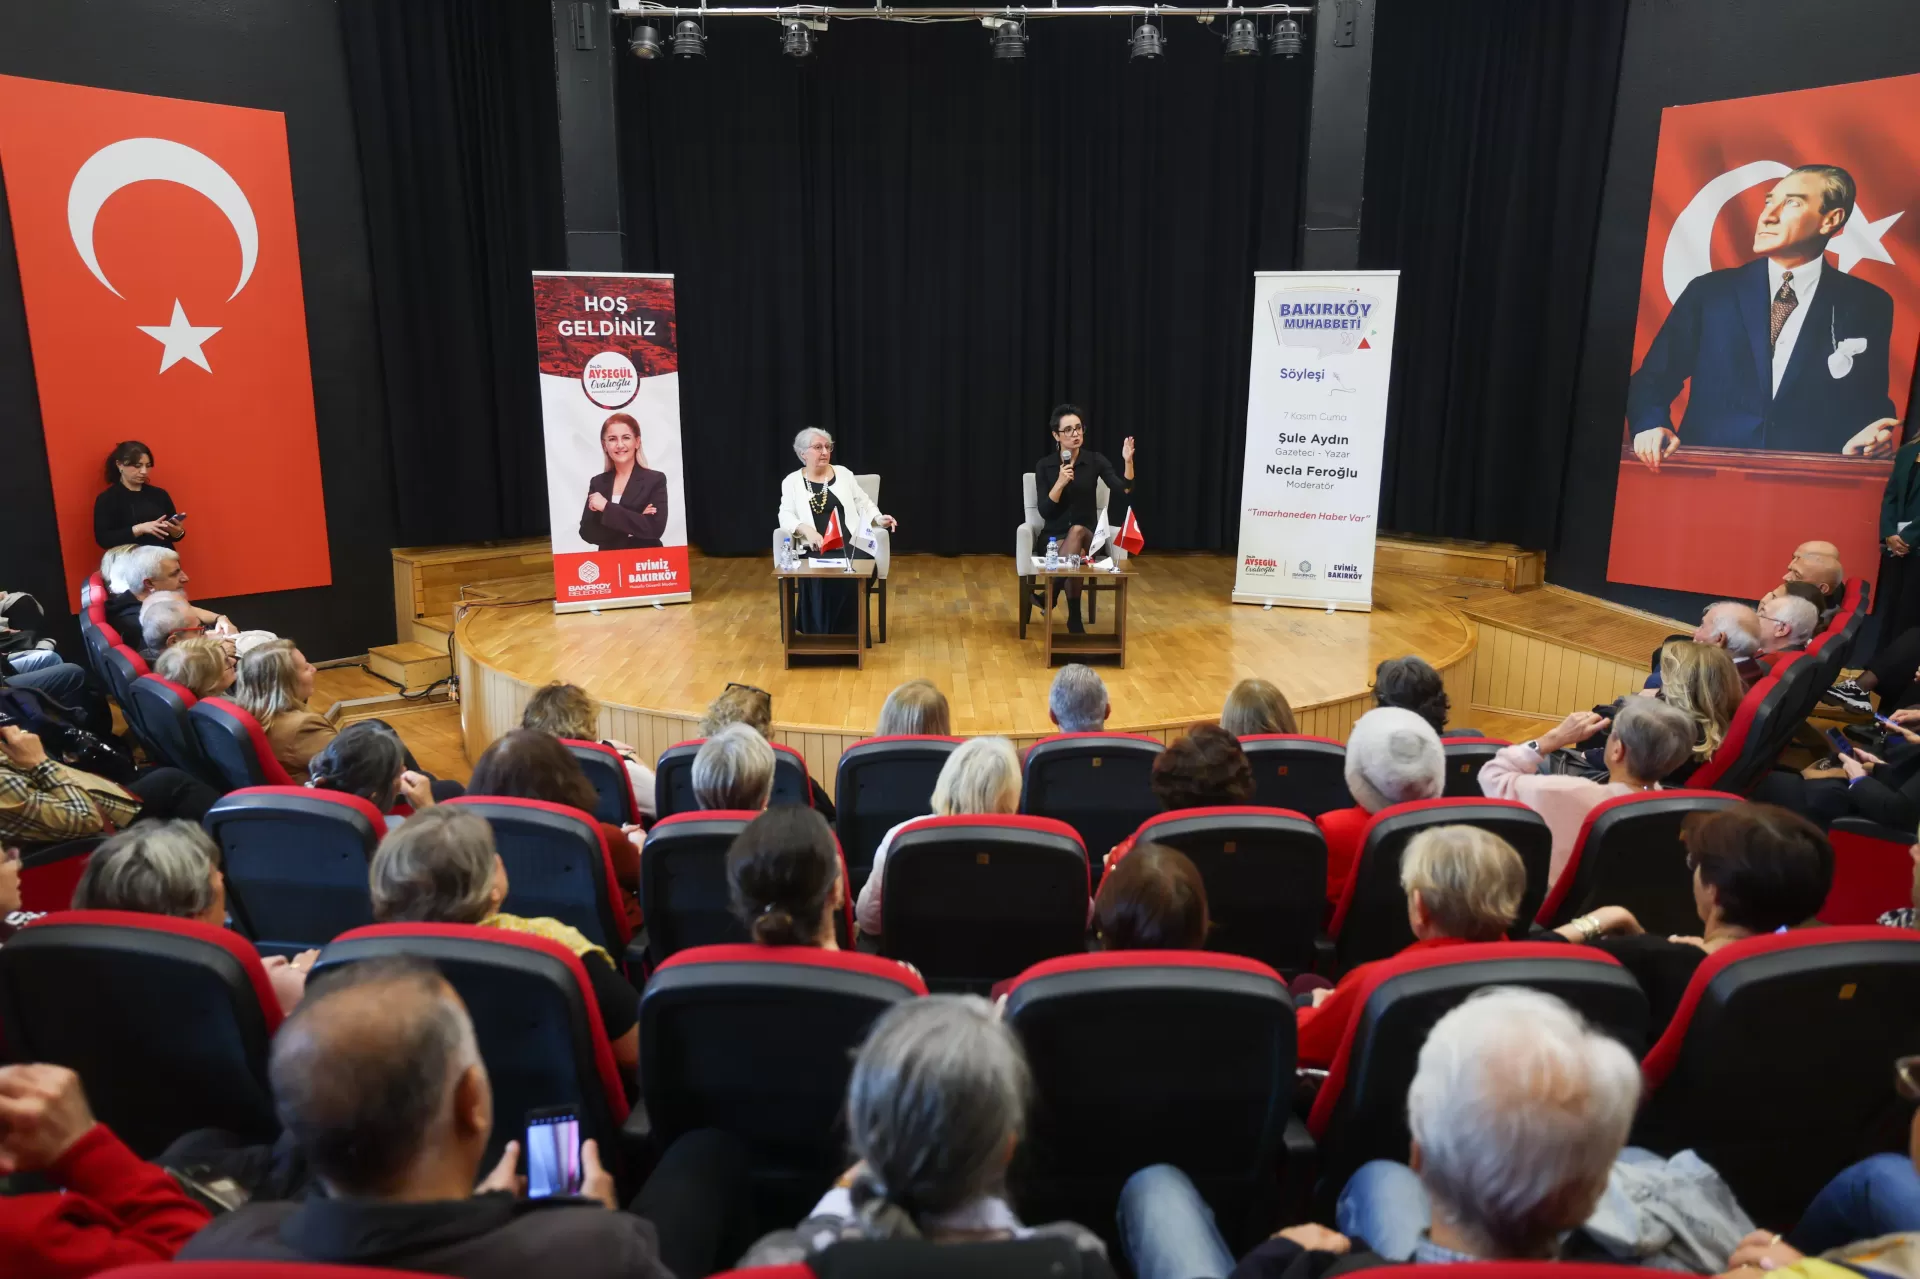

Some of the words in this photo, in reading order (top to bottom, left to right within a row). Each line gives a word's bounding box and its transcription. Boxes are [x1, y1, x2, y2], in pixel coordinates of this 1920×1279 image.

[584, 296, 628, 314] HOŞ
[1280, 300, 1371, 317] BAKIRKÖY
[558, 317, 656, 336] GELDİNİZ
[1283, 316, 1361, 330] MUHABBETİ
[588, 366, 633, 380] AYŞEGÜL
[1280, 368, 1325, 382] Söyleşi
[1283, 411, 1289, 420] 7
[1319, 412, 1347, 421] Cuma
[1279, 432, 1306, 444] Şule
[1310, 433, 1349, 446] Aydın
[1275, 448, 1315, 457] Gazeteci
[1324, 449, 1350, 459] Yazar
[1266, 464, 1302, 476] Necla
[1306, 466, 1358, 479] Feroğlu
[1286, 480, 1334, 490] Moderatör
[1318, 512, 1347, 521] Haber
[636, 558, 669, 572] EVİMİZ
[1333, 563, 1357, 572] EVİMİZ
[628, 570, 677, 583] BAKIRKÖY
[1327, 571, 1362, 580] BAKIRKÖY
